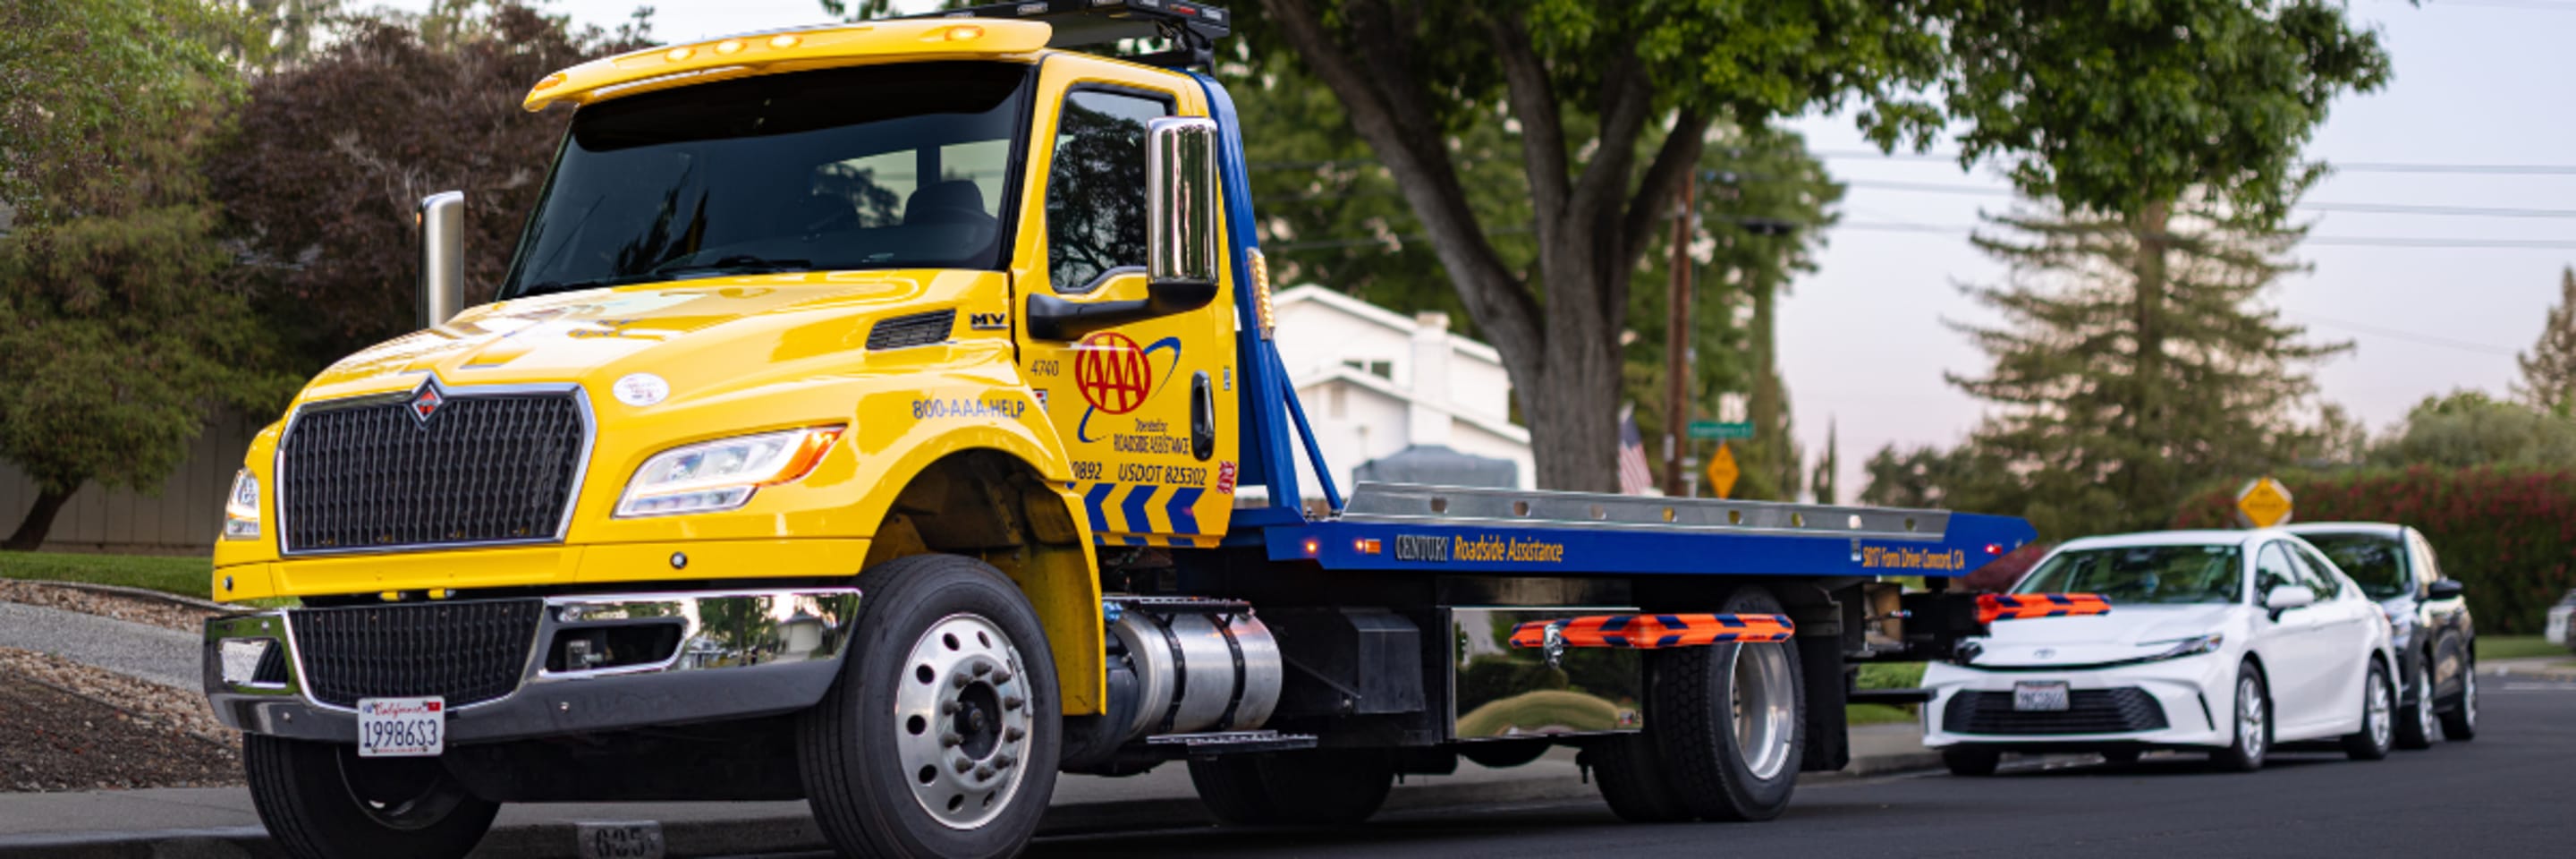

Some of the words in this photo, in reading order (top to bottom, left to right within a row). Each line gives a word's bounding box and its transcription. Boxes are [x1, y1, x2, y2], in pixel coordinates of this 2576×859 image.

[971, 313, 1006, 325] MV
[1030, 360, 1059, 377] 4740
[1079, 334, 1148, 413] AAA
[912, 399, 1025, 419] 800-AAA-HELP
[1118, 463, 1163, 482] USDOT
[1165, 465, 1207, 485] 825302
[1394, 534, 1449, 562] CENTURY
[1453, 534, 1504, 562] Roadside
[1506, 537, 1563, 563] Assistance
[1901, 547, 1920, 568] Drive
[1953, 549, 1965, 569] CA
[364, 719, 437, 748] 19986S3
